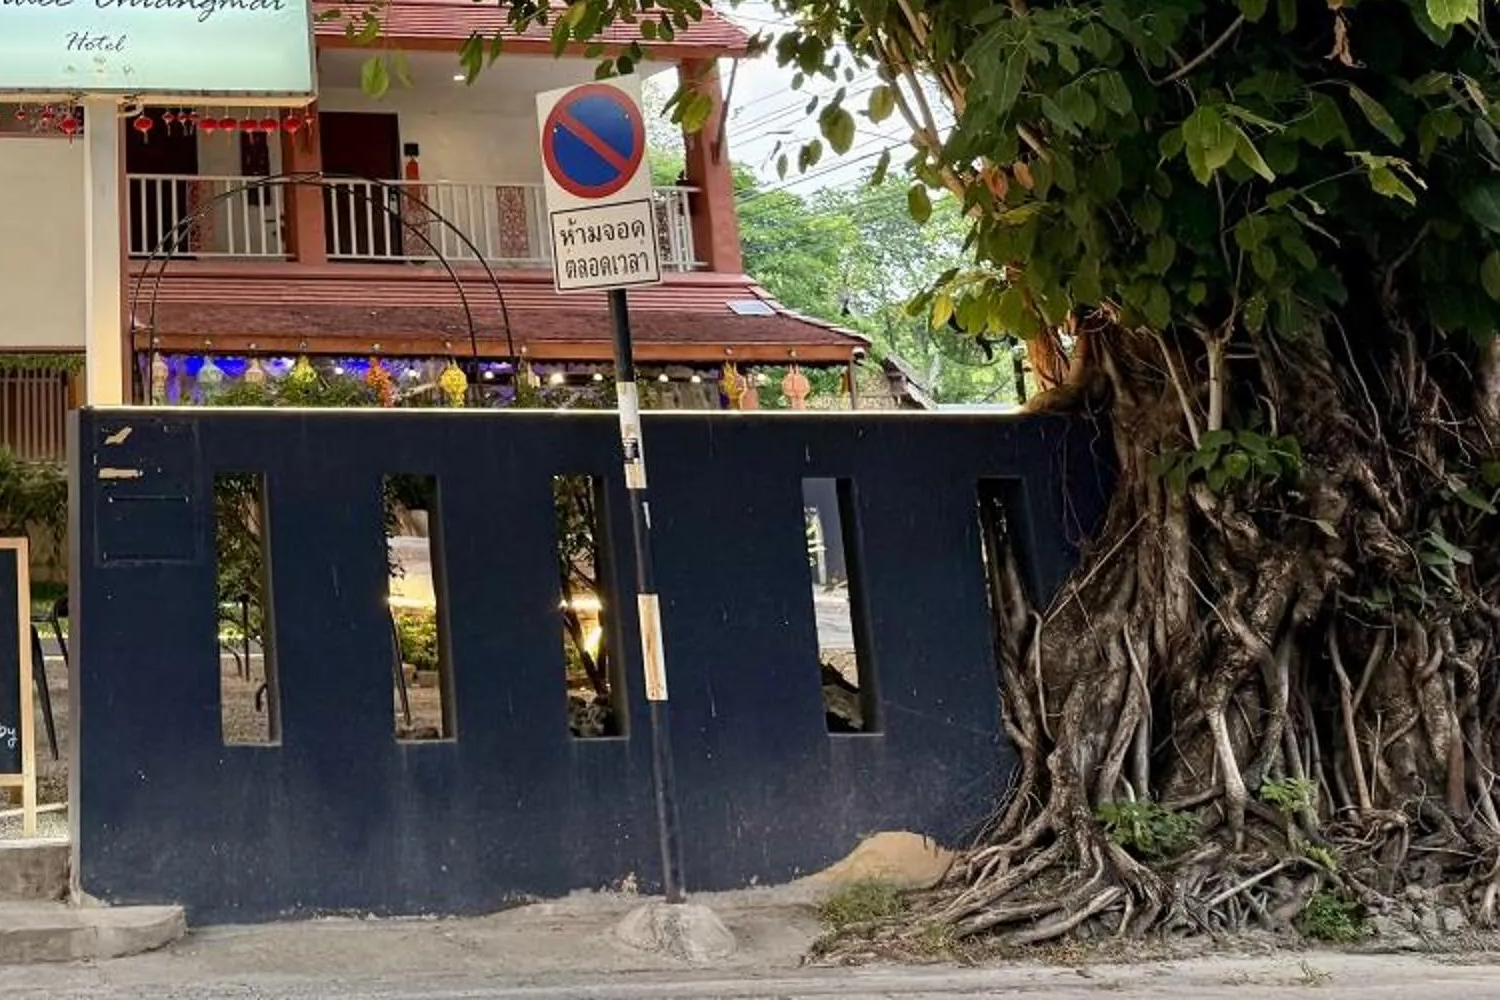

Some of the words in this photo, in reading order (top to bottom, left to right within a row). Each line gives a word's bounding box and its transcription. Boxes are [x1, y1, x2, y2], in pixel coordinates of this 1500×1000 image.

[65, 31, 126, 53] Hotel
[560, 217, 646, 246] ห้ามจอด
[565, 251, 650, 279] ตลอดเวลา
